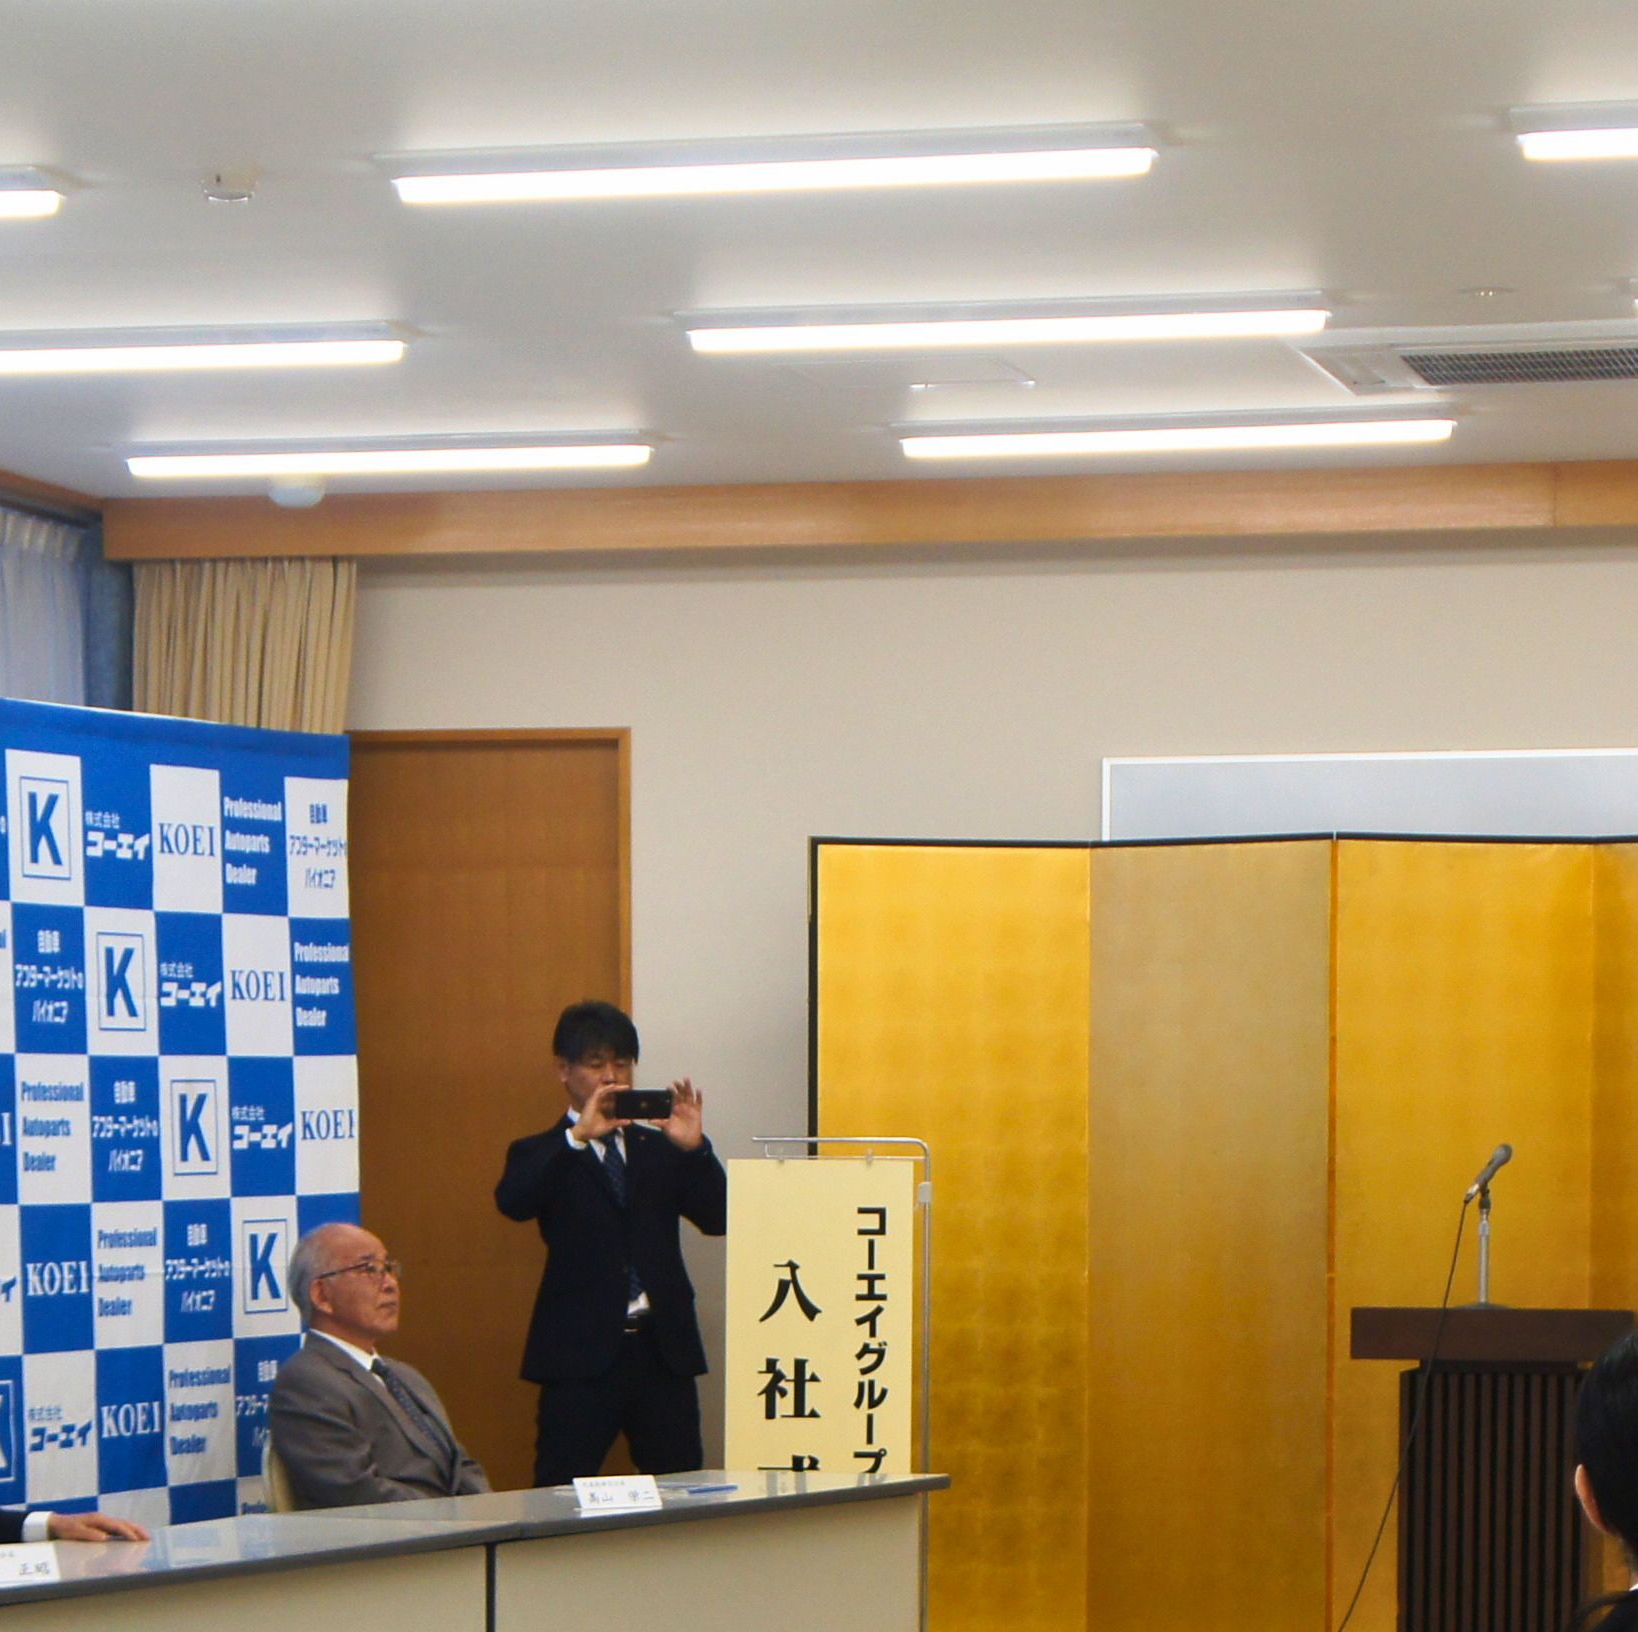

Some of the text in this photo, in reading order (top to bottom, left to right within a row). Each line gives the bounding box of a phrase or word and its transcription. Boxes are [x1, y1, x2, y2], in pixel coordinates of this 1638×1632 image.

[223, 796, 282, 821] Professional
[28, 791, 63, 866] K
[85, 811, 120, 829] 株式会社
[86, 831, 150, 860] コーエイ
[158, 823, 216, 857] KOEI
[225, 830, 270, 853] Autoparts
[225, 863, 257, 884] Dealer
[160, 962, 193, 978] 株式会社
[105, 946, 139, 1017] K
[230, 970, 287, 1001] KOEI
[295, 974, 339, 996] Autoparts
[160, 981, 222, 1008] コーエイ
[296, 1007, 327, 1027] Dealer
[21, 1081, 84, 1102] Professional
[232, 1105, 265, 1120] 株式会社
[23, 1116, 71, 1138] Autoparts
[179, 1093, 211, 1162] K
[232, 1122, 293, 1149] コーエイ
[301, 1109, 354, 1140] KOEI
[23, 1152, 56, 1172] Dealer
[98, 1227, 157, 1249] Professional
[98, 1263, 146, 1284] Autoparts
[249, 1232, 282, 1300] K
[26, 1261, 90, 1296] KOEI
[98, 1297, 132, 1317] Dealer
[853, 1206, 888, 1473] コーエイグループ
[170, 1366, 231, 1388] Professional
[28, 1406, 62, 1421] 株式会社
[101, 1401, 161, 1438] KOEI
[170, 1402, 218, 1422] Autoparts
[29, 1420, 93, 1452] コーエイ
[170, 1435, 206, 1455] Dealer
